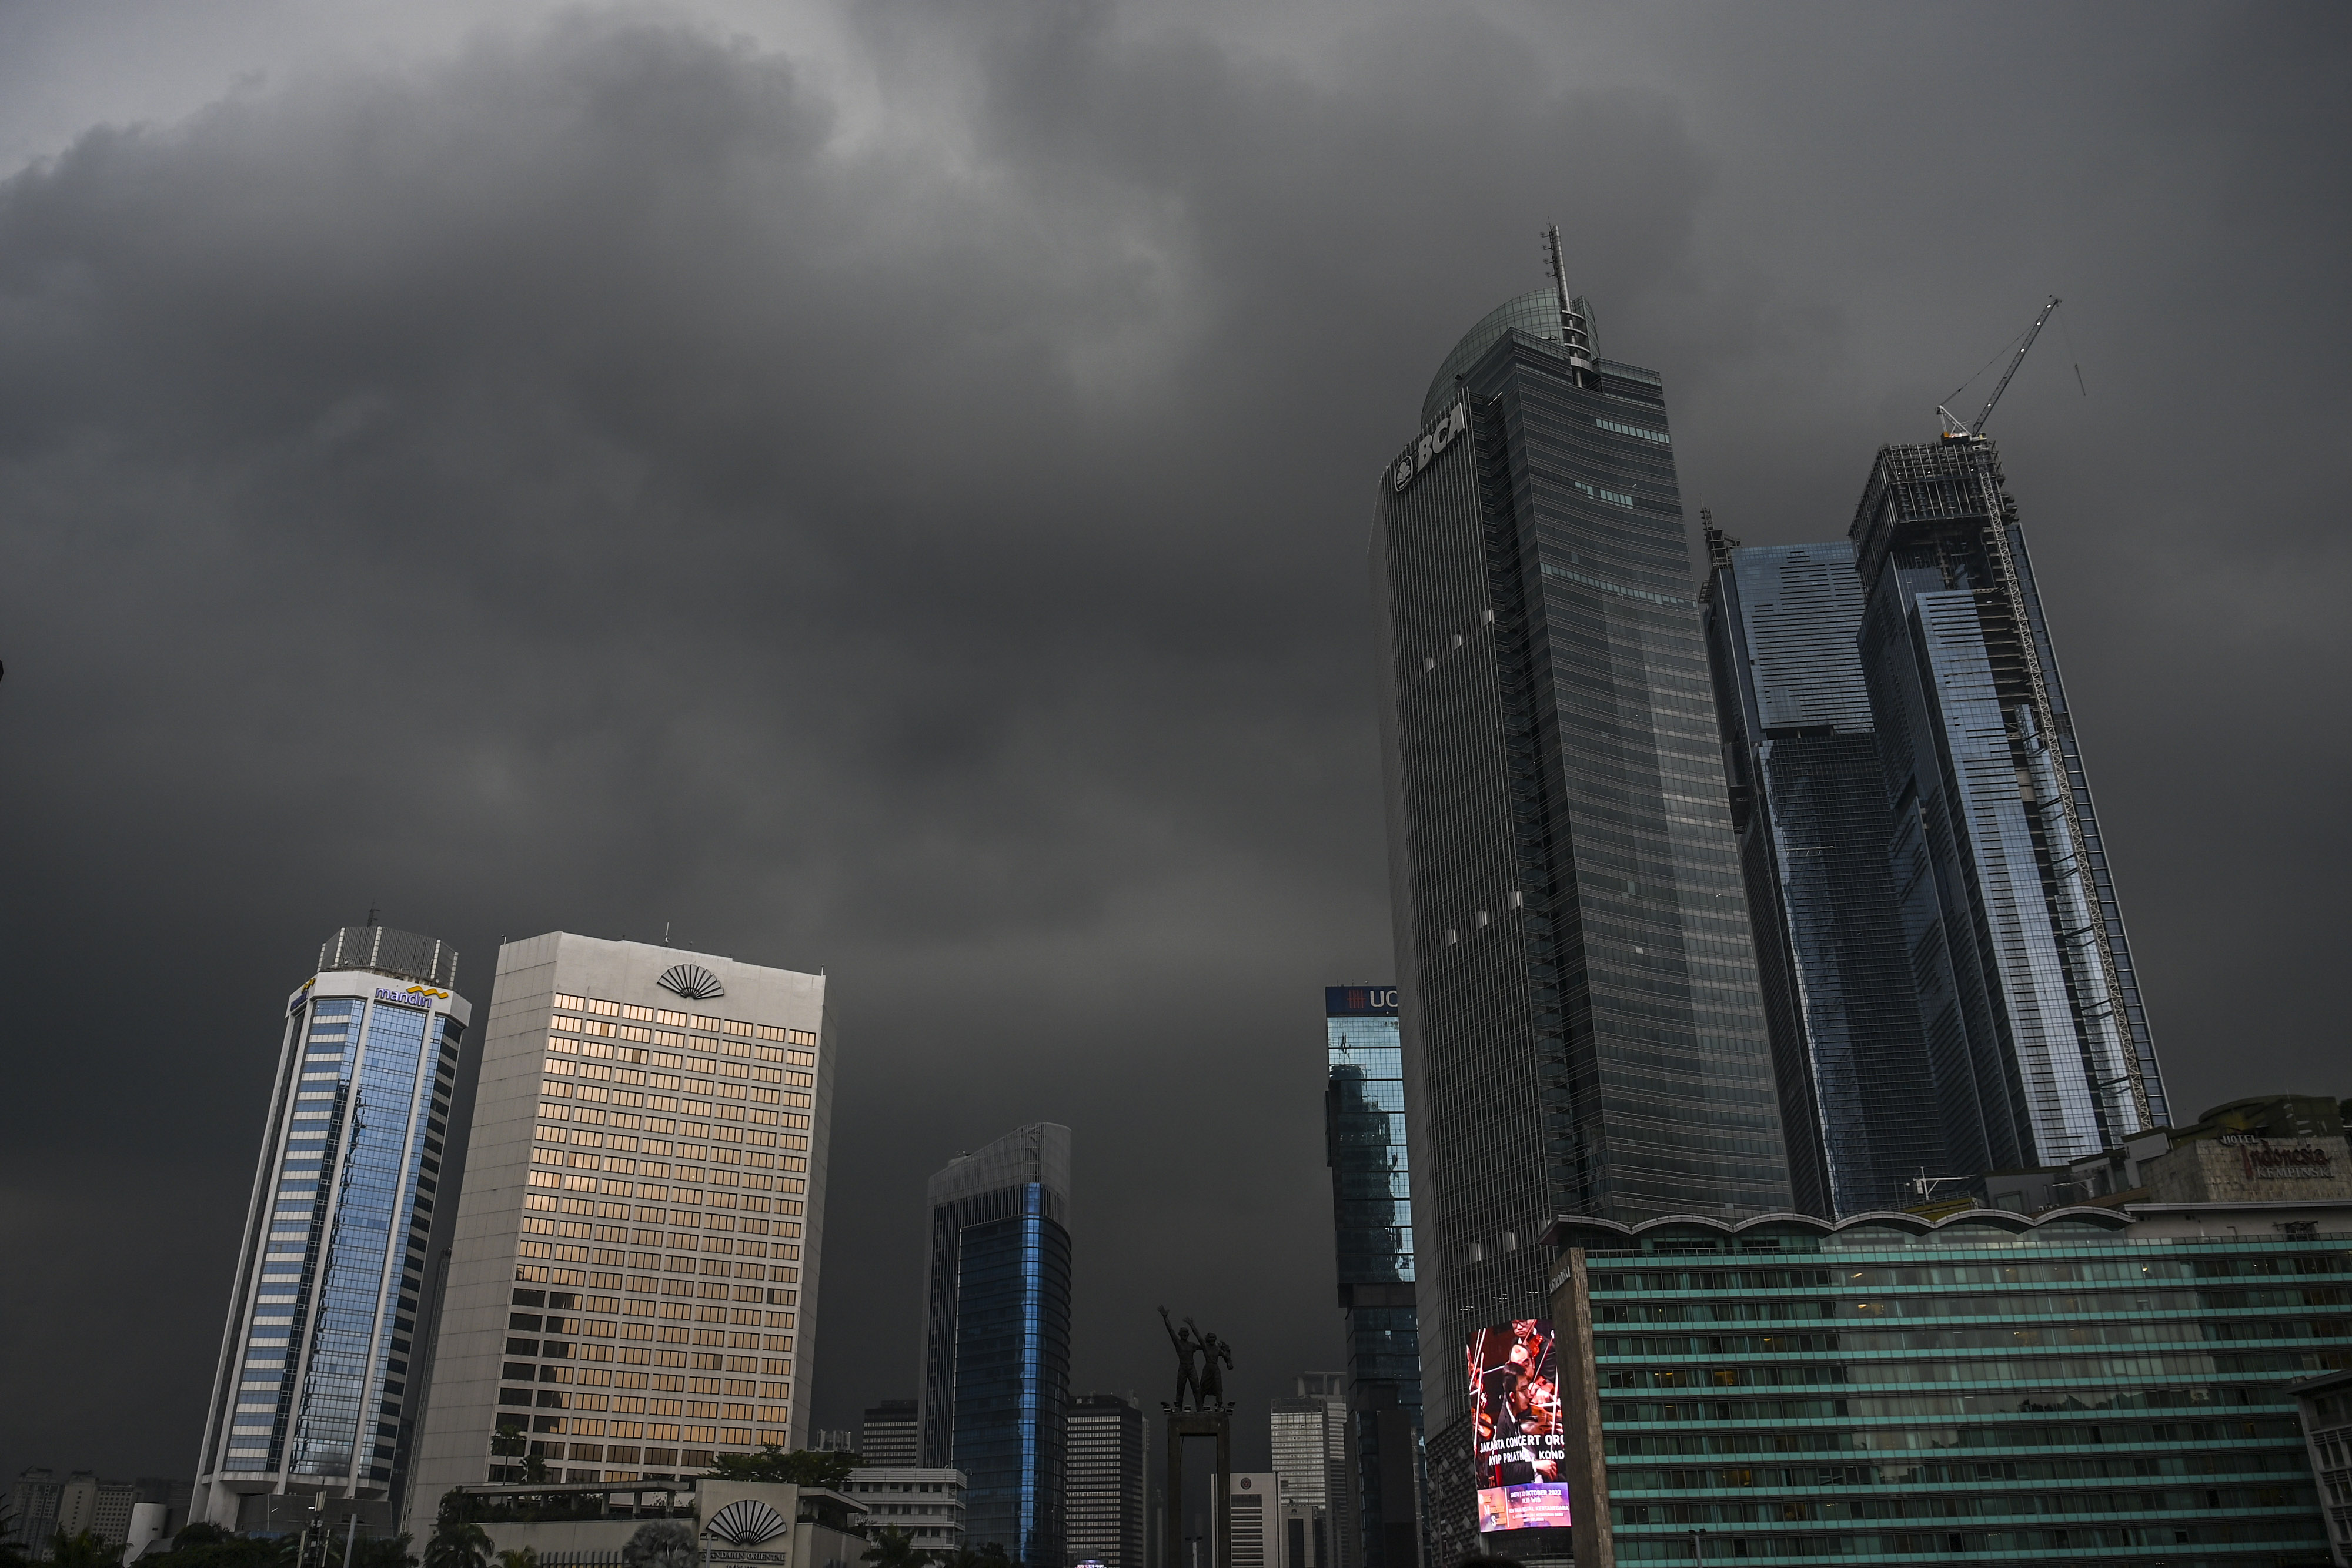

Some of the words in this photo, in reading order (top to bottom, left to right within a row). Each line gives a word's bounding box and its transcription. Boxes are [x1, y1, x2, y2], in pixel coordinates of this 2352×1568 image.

[1418, 402, 1465, 473] BCA
[375, 988, 432, 1008] mandiri
[2223, 1134, 2259, 1144] HOTEL
[2238, 1138, 2333, 1179] Indonesia
[2257, 1167, 2334, 1179] KEMPINSKI
[1480, 1439, 1505, 1453] JAKARTA
[1506, 1435, 1541, 1448] CONCERT
[1489, 1454, 1502, 1466] AVIP
[747, 1553, 785, 1562] ORIENTAL
